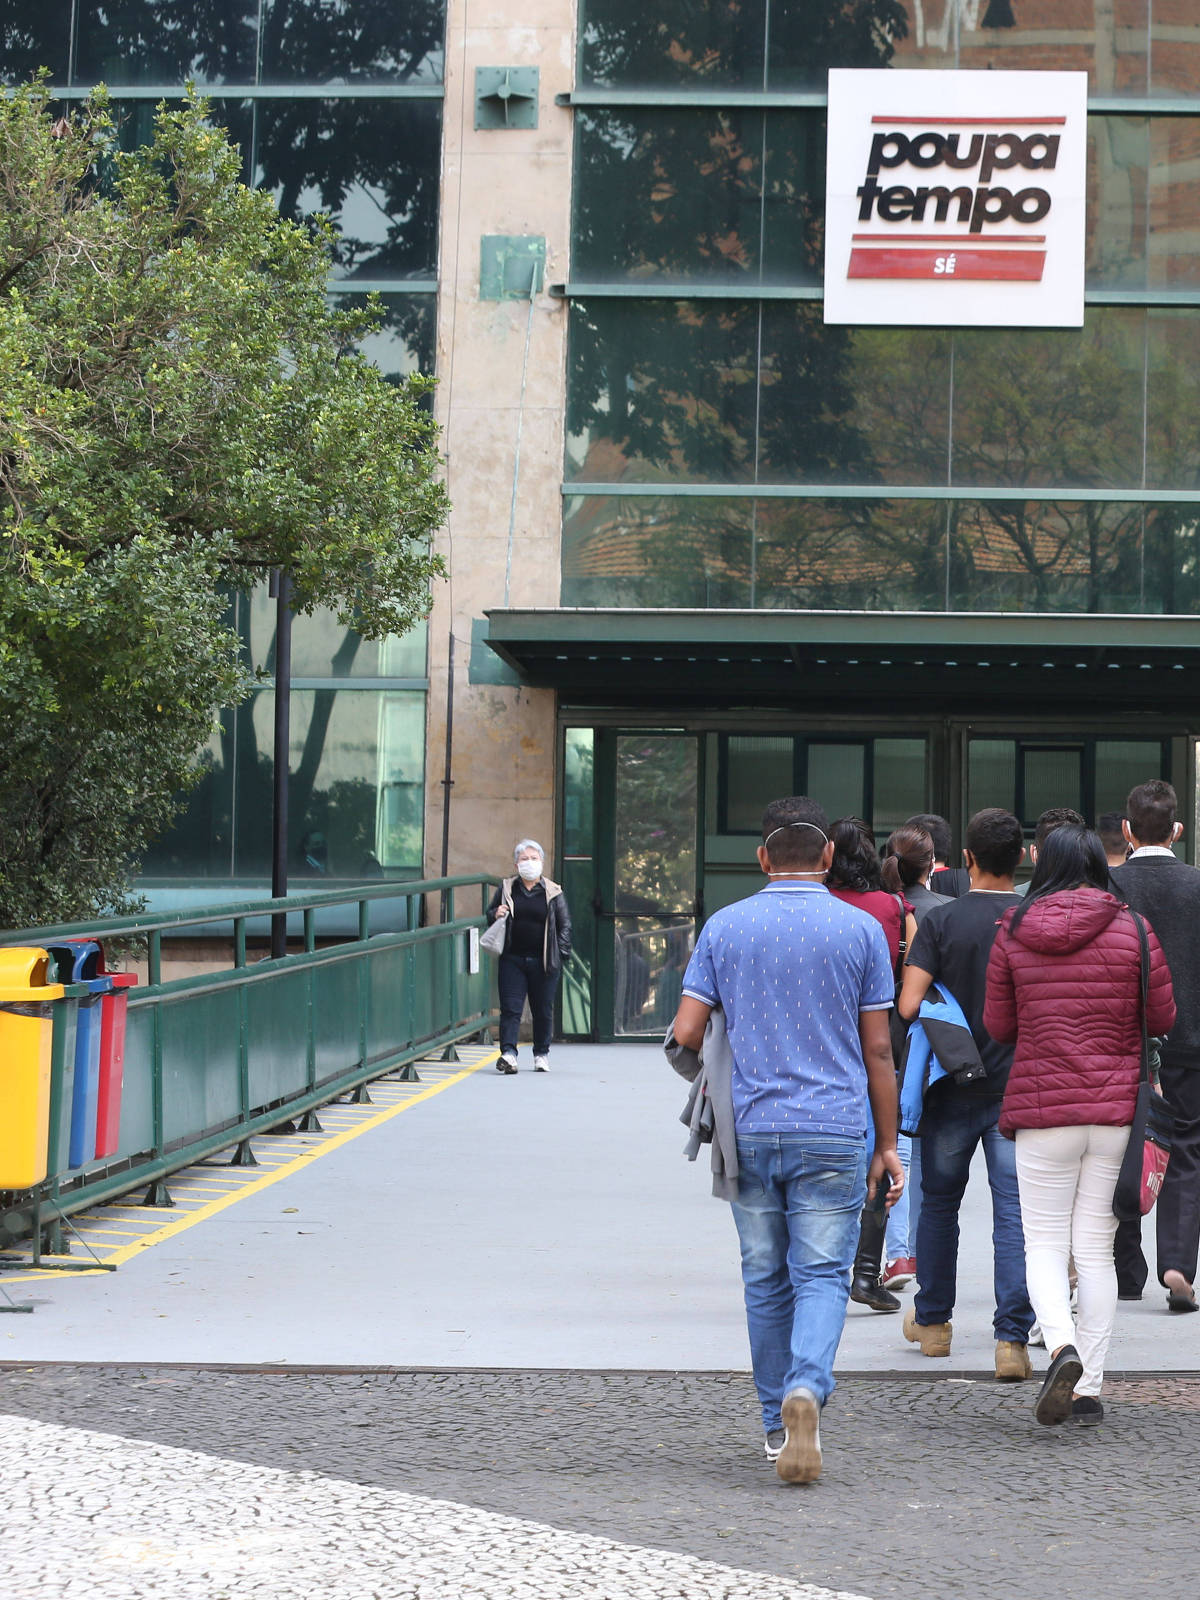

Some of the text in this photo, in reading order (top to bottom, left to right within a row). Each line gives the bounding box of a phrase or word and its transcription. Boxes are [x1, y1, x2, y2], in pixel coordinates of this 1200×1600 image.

[866, 132, 1061, 183] poupa
[856, 177, 1052, 233] tempo
[934, 253, 956, 274] SÉ
